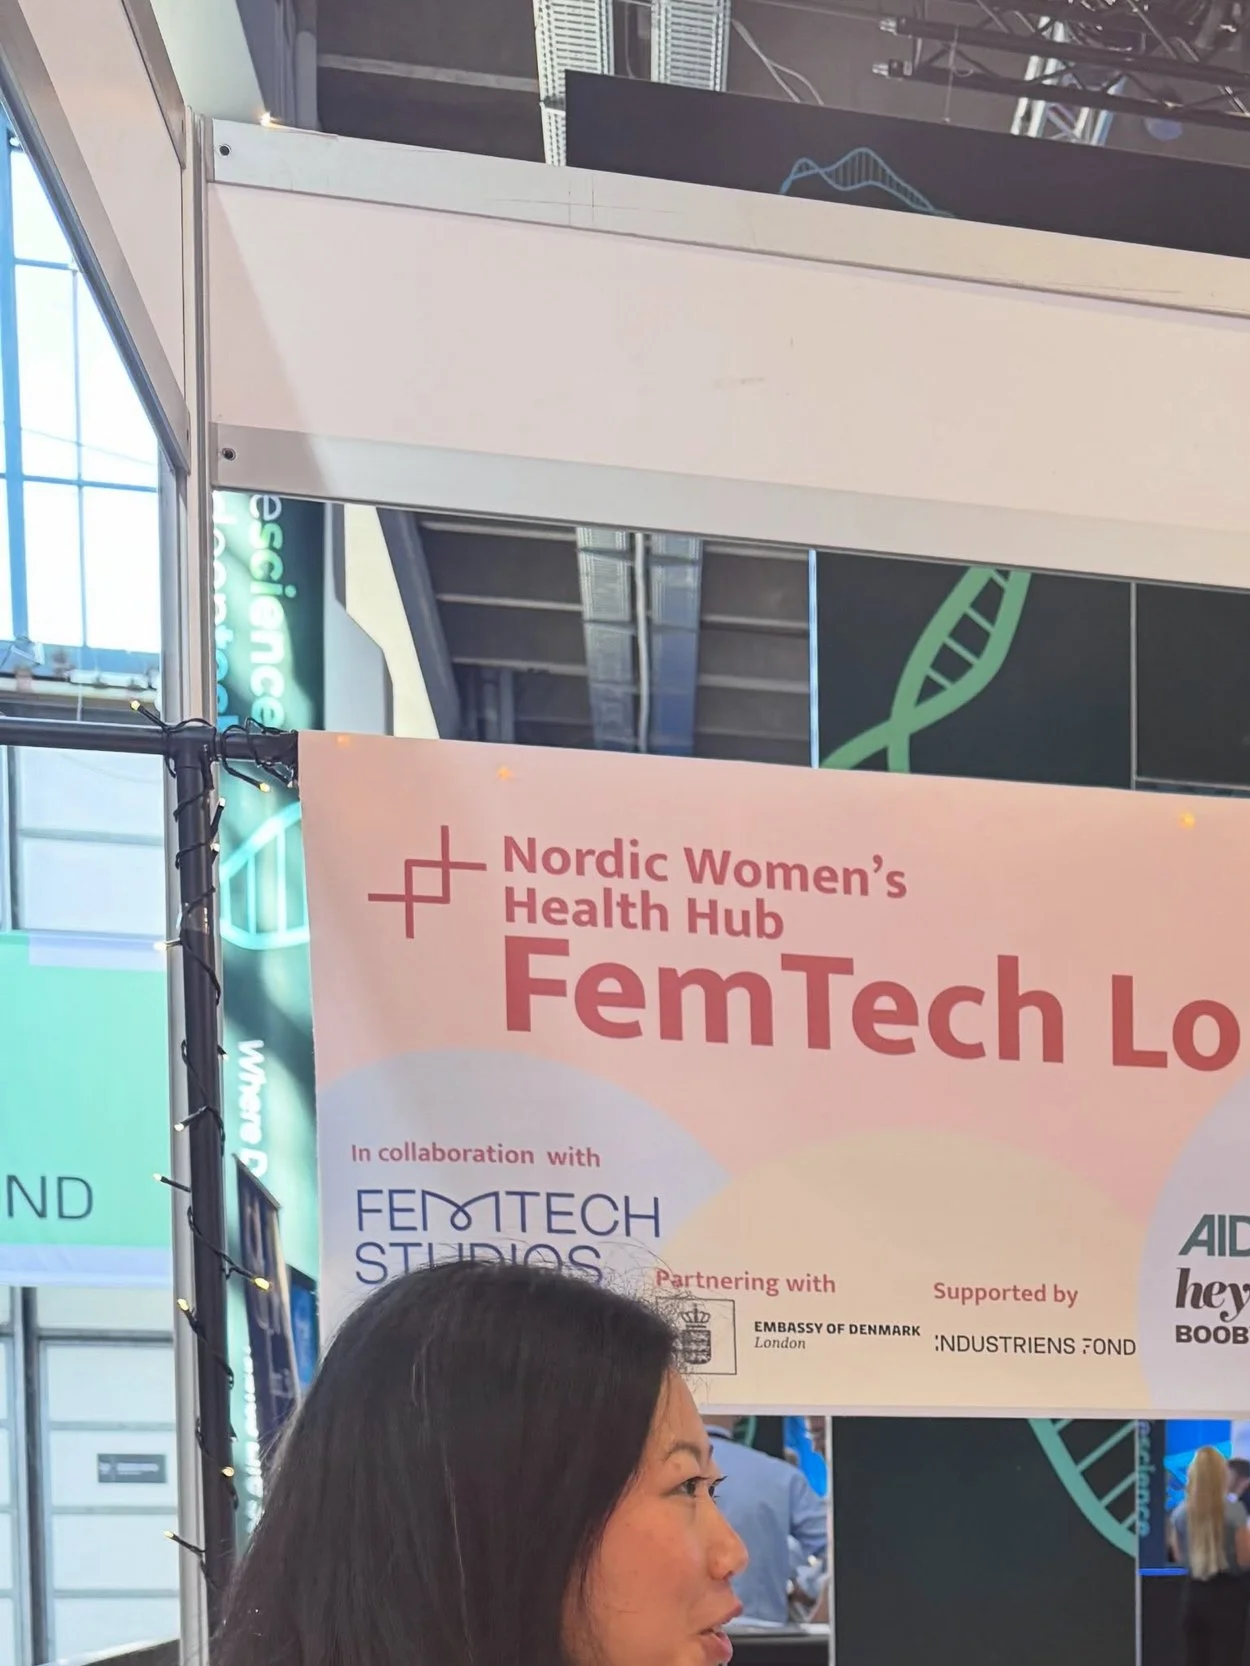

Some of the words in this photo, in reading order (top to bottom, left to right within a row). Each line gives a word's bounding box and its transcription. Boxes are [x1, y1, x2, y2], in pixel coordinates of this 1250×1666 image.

[504, 836, 668, 883] Nordic
[684, 846, 907, 899] Women's
[504, 886, 669, 932] Health
[687, 899, 784, 940] Hub
[505, 935, 1063, 1064] FemTech
[352, 1145, 371, 1162] In
[378, 1142, 534, 1165] collaboration
[547, 1146, 601, 1168] with
[6, 1174, 93, 1219] ND
[357, 1188, 660, 1238] FEMTECH
[655, 1269, 779, 1297] Partnering
[786, 1275, 836, 1294] with
[933, 1282, 1046, 1305] Supported
[1053, 1283, 1079, 1308] by
[754, 1321, 823, 1335] EMBASSY
[826, 1323, 846, 1335] OF
[849, 1323, 921, 1337] DENMARK
[754, 1335, 807, 1350] London
[1175, 1325, 1249, 1345] BOOB
